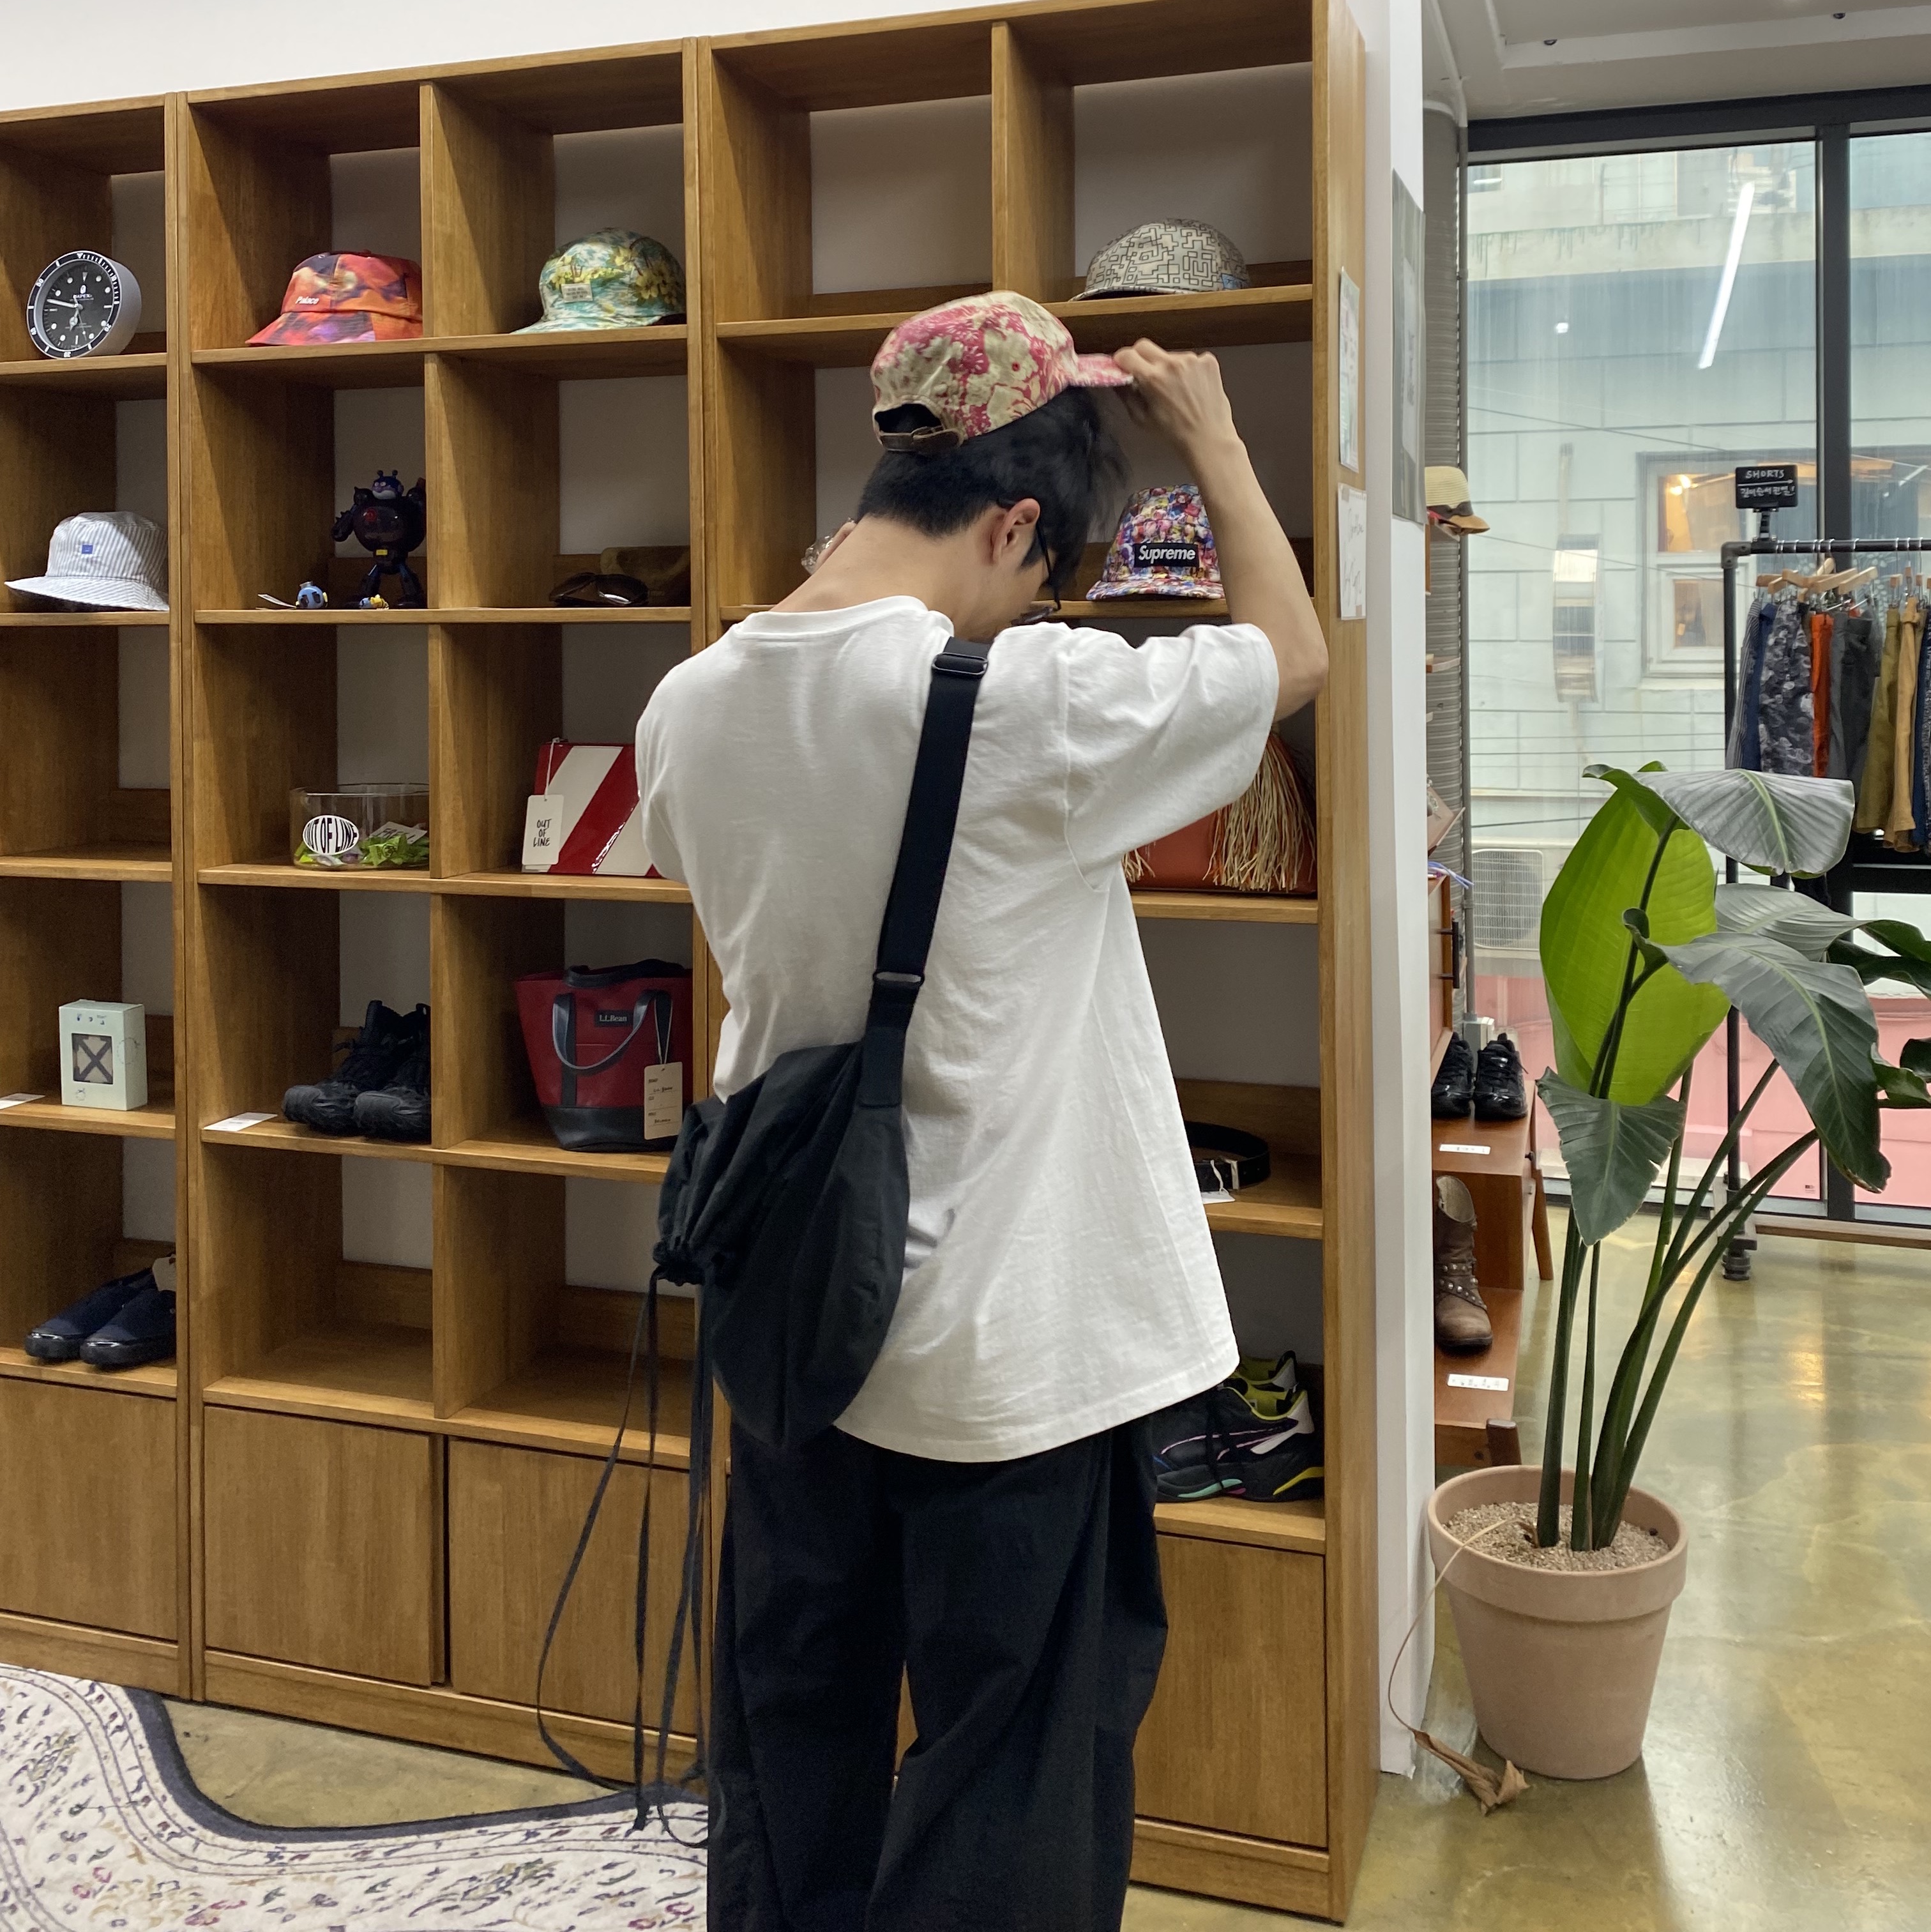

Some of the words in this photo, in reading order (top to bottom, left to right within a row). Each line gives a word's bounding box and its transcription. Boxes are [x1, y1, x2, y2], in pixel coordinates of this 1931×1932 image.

[295, 296, 320, 305] Palace
[1745, 469, 1785, 478] SHORTS
[1138, 545, 1196, 564] Supreme
[536, 819, 552, 828] OUT
[320, 818, 332, 853] OF
[334, 818, 358, 853] LINE
[538, 828, 548, 837] OF
[533, 837, 550, 847] LINE
